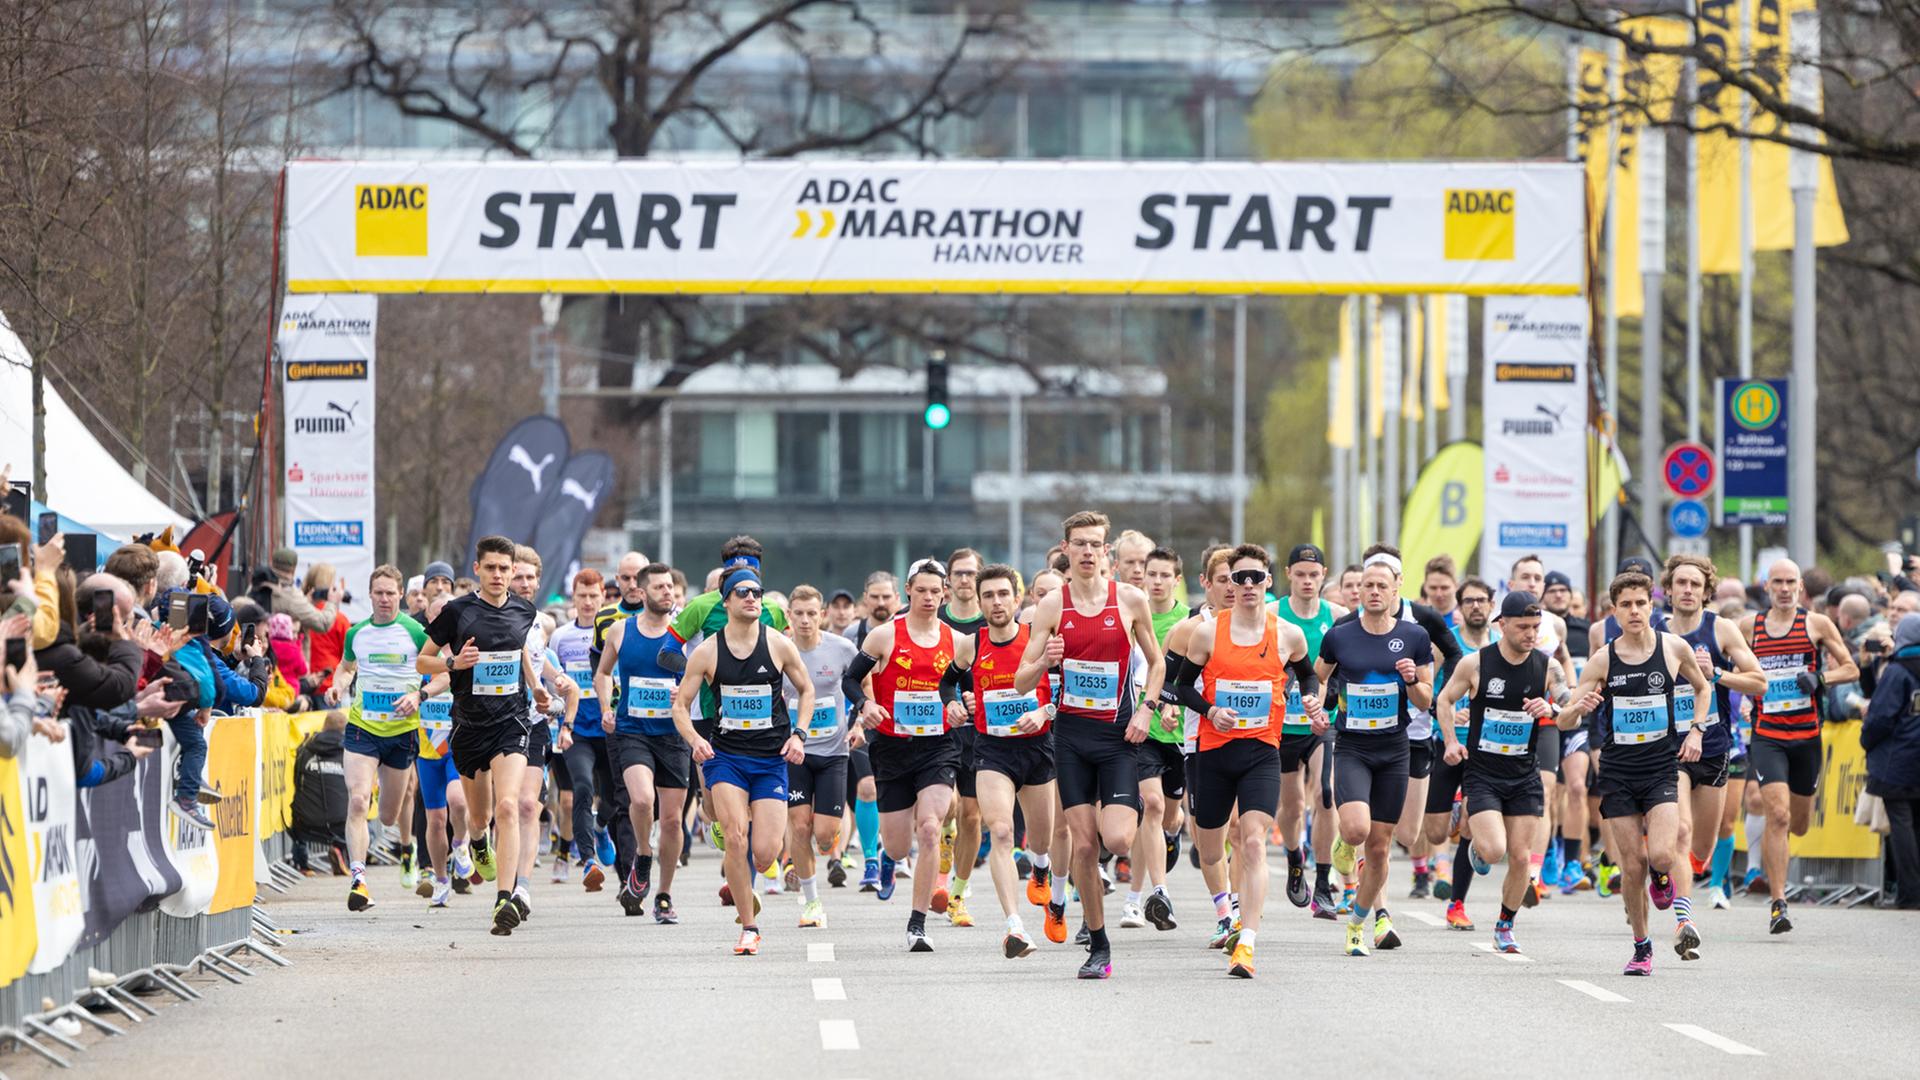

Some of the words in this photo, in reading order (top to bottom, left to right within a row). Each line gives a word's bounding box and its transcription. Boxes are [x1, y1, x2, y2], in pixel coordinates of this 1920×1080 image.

[359, 187, 425, 210] ADAC
[797, 179, 899, 204] ADAC
[1448, 192, 1512, 214] ADAC
[479, 192, 737, 250] START
[841, 209, 1082, 238] MARATHON
[1135, 193, 1392, 252] START
[934, 243, 1083, 263] HANNOVER
[284, 312, 315, 320] ADAC
[297, 320, 371, 330] MARATHON
[288, 362, 355, 379] Continental
[1747, 394, 1766, 418] H
[295, 417, 346, 434] PUMA
[1503, 420, 1553, 435] PUMA
[310, 471, 368, 484] Sparkasse
[1441, 482, 1468, 526] B
[297, 524, 348, 535] ERDINGER
[485, 664, 514, 676] 12230
[1074, 675, 1108, 689] 12535
[638, 690, 667, 701] 12432
[1226, 695, 1262, 708] 11697
[731, 699, 763, 710] 11483
[905, 704, 935, 717] 11362
[995, 702, 1029, 717] 12966
[1357, 698, 1389, 709] 11493
[1623, 710, 1656, 724] 12871
[1494, 724, 1524, 736] 10658
